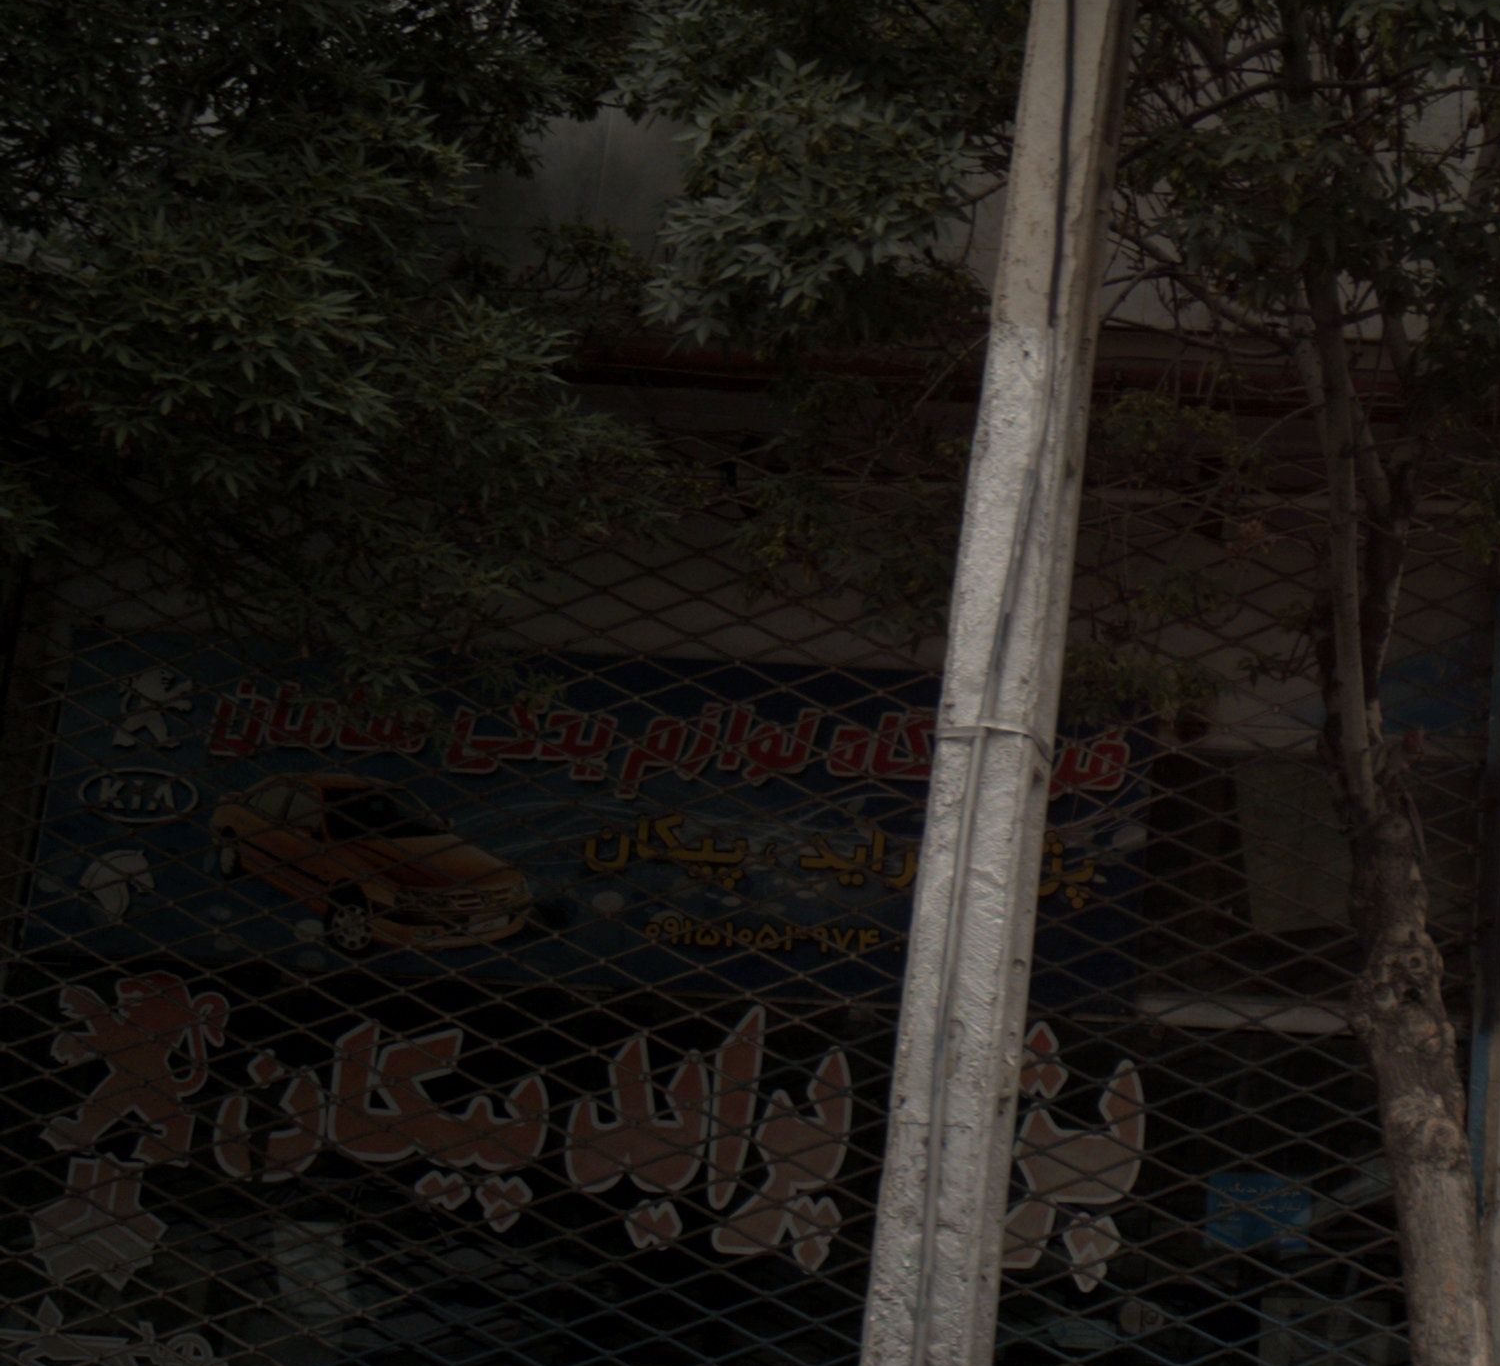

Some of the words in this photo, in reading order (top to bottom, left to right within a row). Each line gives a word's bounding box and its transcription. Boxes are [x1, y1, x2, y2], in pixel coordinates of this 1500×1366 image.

[614, 701, 823, 800] لوازم
[101, 779, 176, 813] KIA
[584, 813, 748, 890] پیکان
[799, 827, 918, 889] راید
[1038, 830, 1096, 910] پژ
[212, 1019, 549, 1233] پیکان
[565, 1003, 854, 1275] پراید
[1002, 1019, 1147, 1294] پژ
